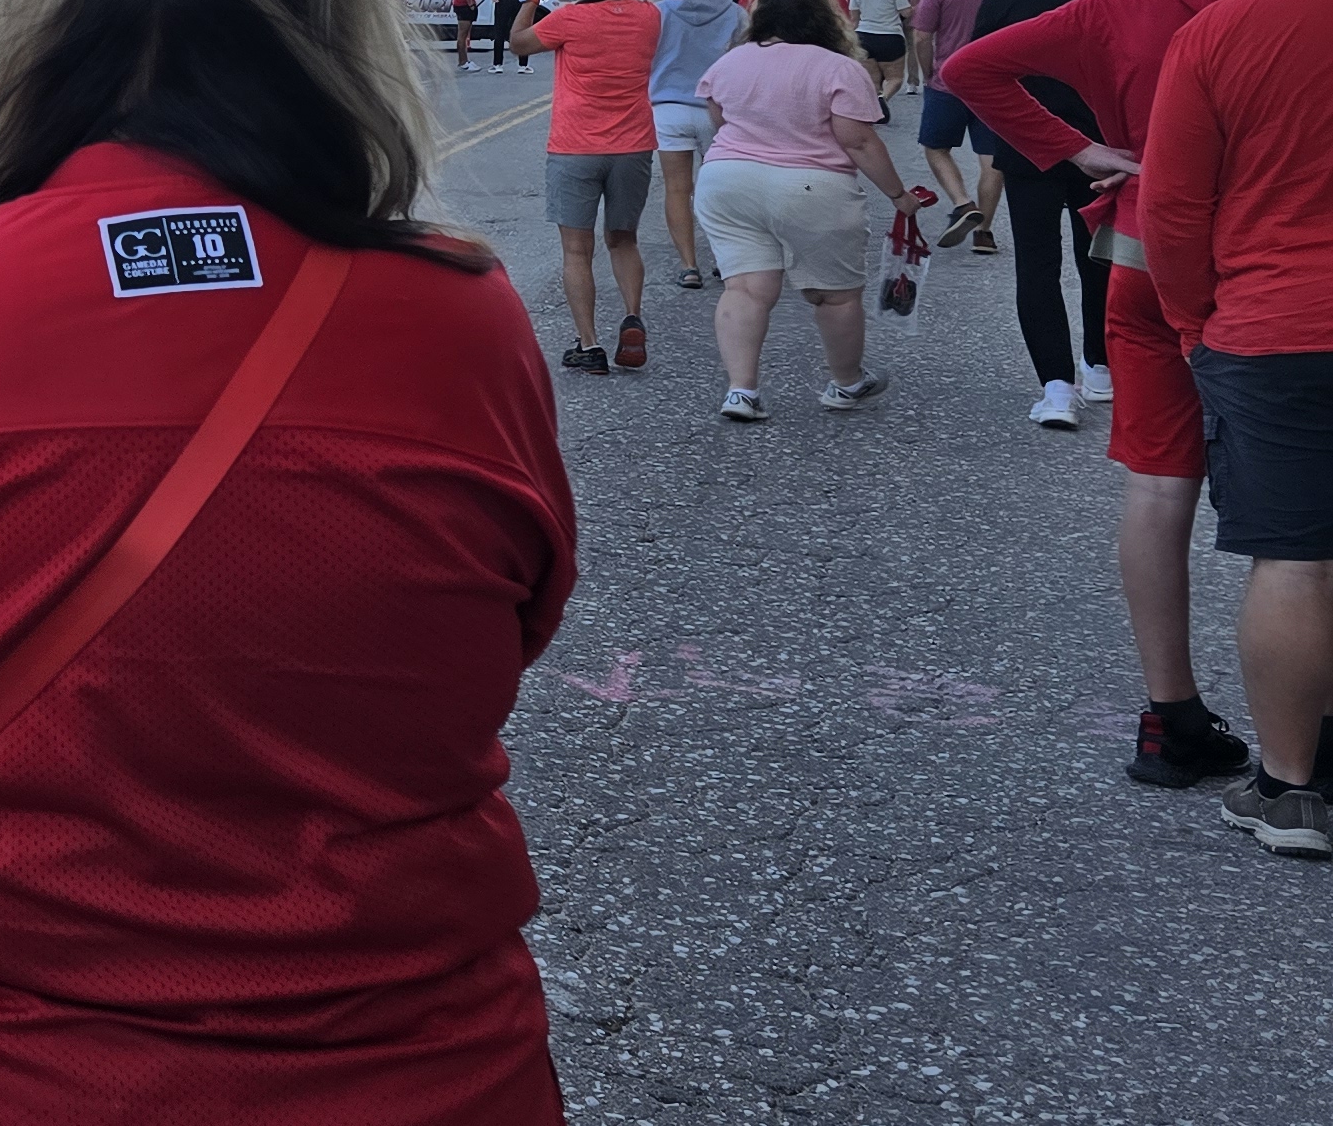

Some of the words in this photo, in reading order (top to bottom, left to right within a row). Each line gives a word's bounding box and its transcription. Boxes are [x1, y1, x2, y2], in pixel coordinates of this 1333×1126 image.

[170, 218, 238, 230] AUTHENTIC
[114, 228, 167, 259] GC
[192, 233, 226, 258] 10
[122, 259, 169, 270] GAMEDAY
[123, 267, 171, 279] COUTURE
